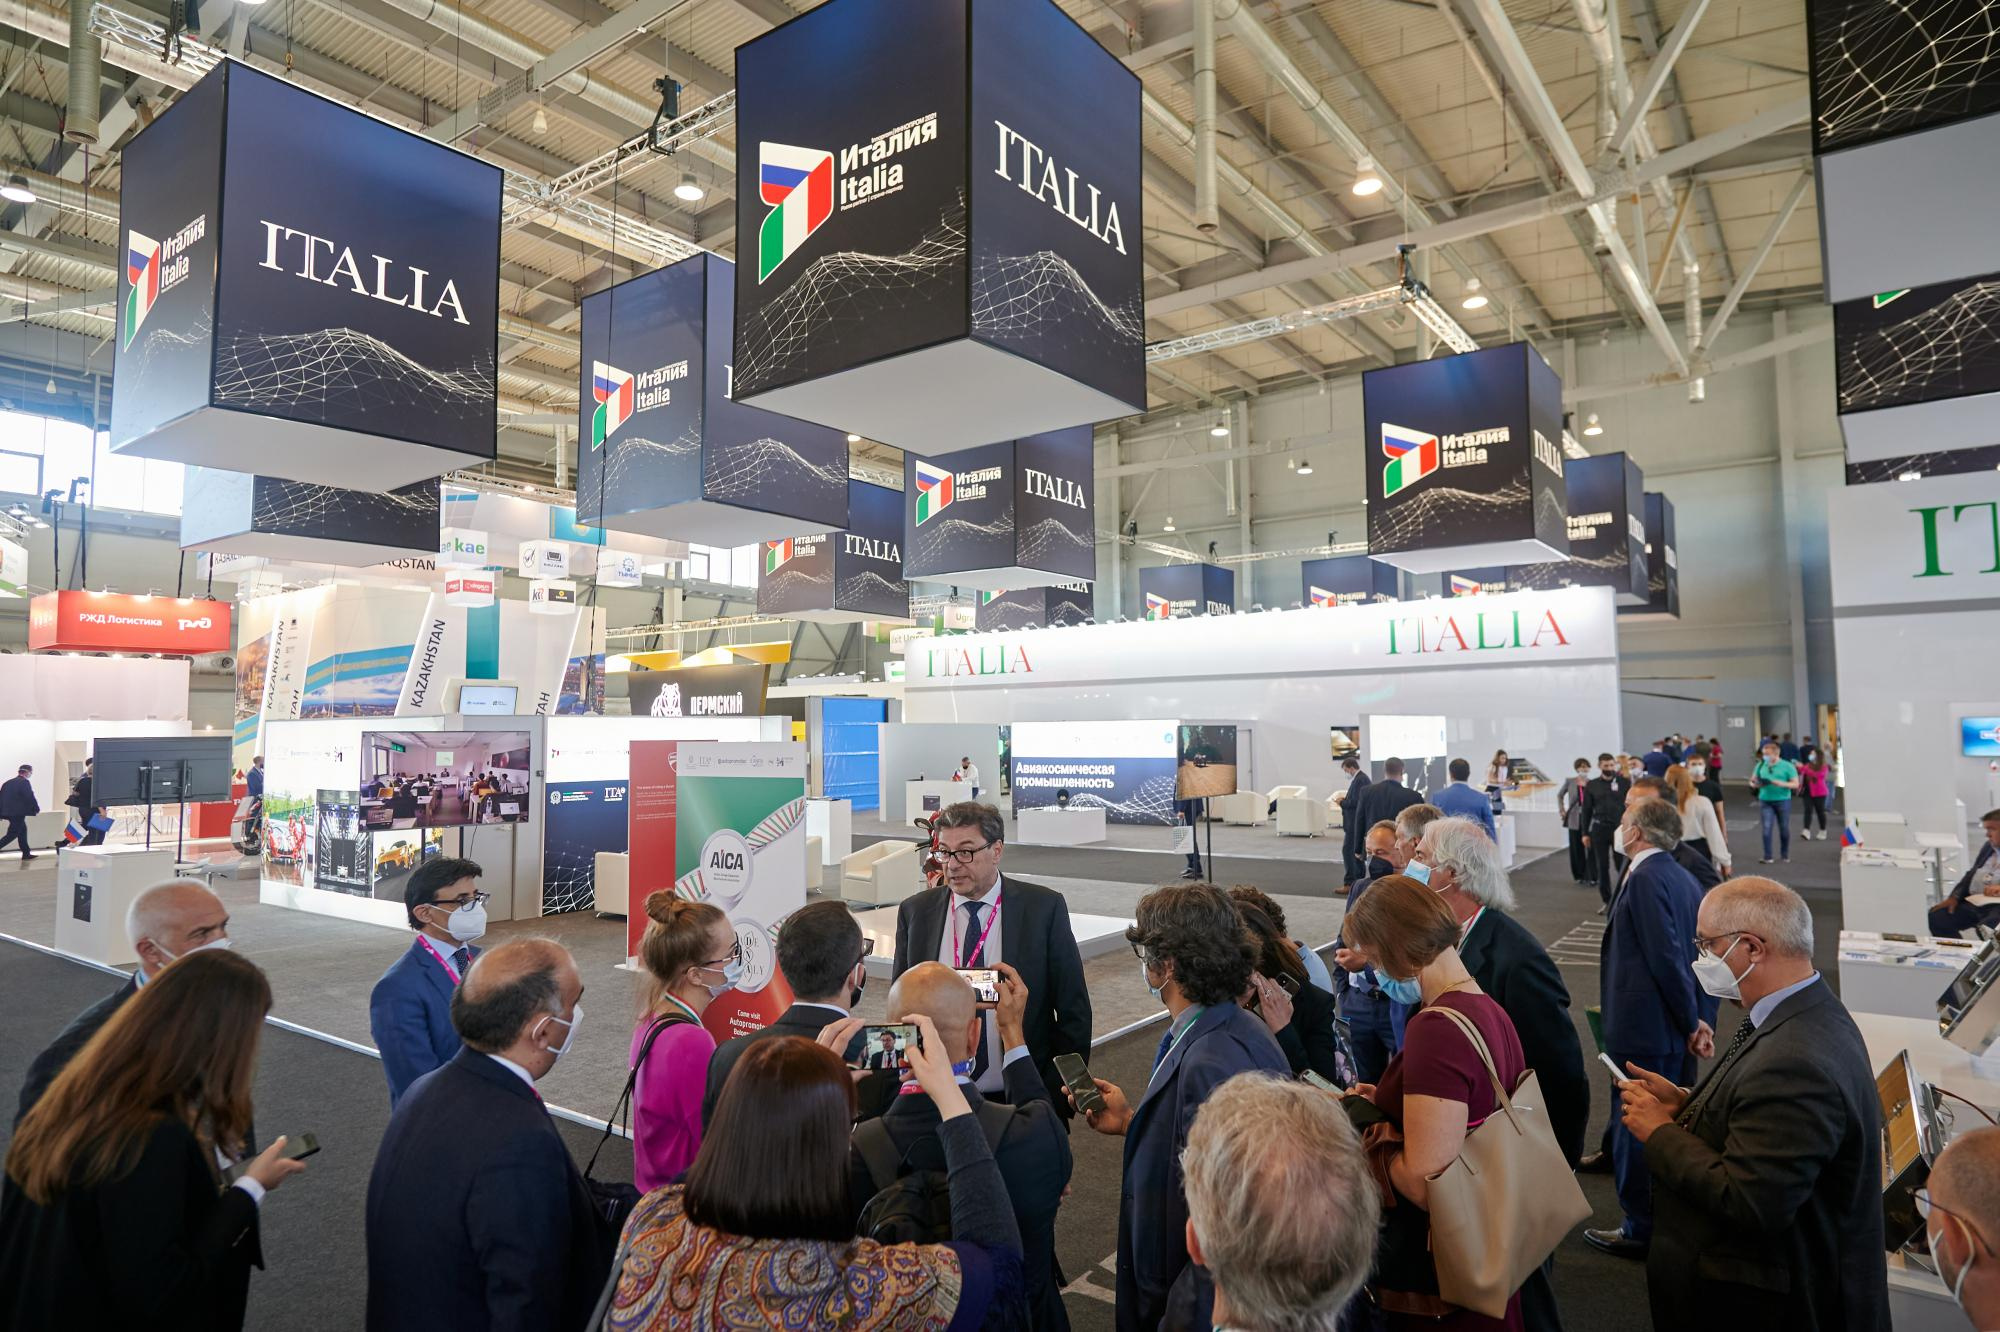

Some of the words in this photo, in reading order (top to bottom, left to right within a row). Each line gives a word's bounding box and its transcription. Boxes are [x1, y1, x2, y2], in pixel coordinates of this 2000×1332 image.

[840, 119, 937, 176] Италия
[840, 162, 904, 206] Italia
[994, 120, 1128, 256] ITALIA
[162, 219, 206, 263] Италия
[161, 255, 190, 289] Italia
[258, 219, 471, 326] ITALIA
[636, 364, 688, 391] Италия
[636, 386, 671, 409] Italia
[1441, 428, 1510, 450] Италия
[1442, 447, 1488, 466] Italia
[1533, 429, 1564, 479] ITALIA
[955, 468, 1002, 486] Италия
[1024, 468, 1087, 509] ITALIA
[955, 484, 987, 500] Italia
[1567, 525, 1597, 540] talia
[454, 537, 486, 555] kae
[794, 544, 816, 556] Italia
[844, 533, 902, 563] ITALIA
[381, 557, 436, 571] QSTAN
[79, 613, 106, 624] РЖД
[107, 614, 163, 627] Логистика
[1385, 609, 1571, 655] ITALIA
[267, 620, 285, 710] KAZAKHSTAN
[410, 619, 446, 708] KAZAKHSTAN
[926, 644, 1034, 678] ITALIA
[690, 690, 743, 715] ПЕРМСКИЙ
[1015, 762, 1115, 775] Авиакосмическая
[1015, 776, 1115, 789] промышленность
[729, 1017, 767, 1031] Autopromote
